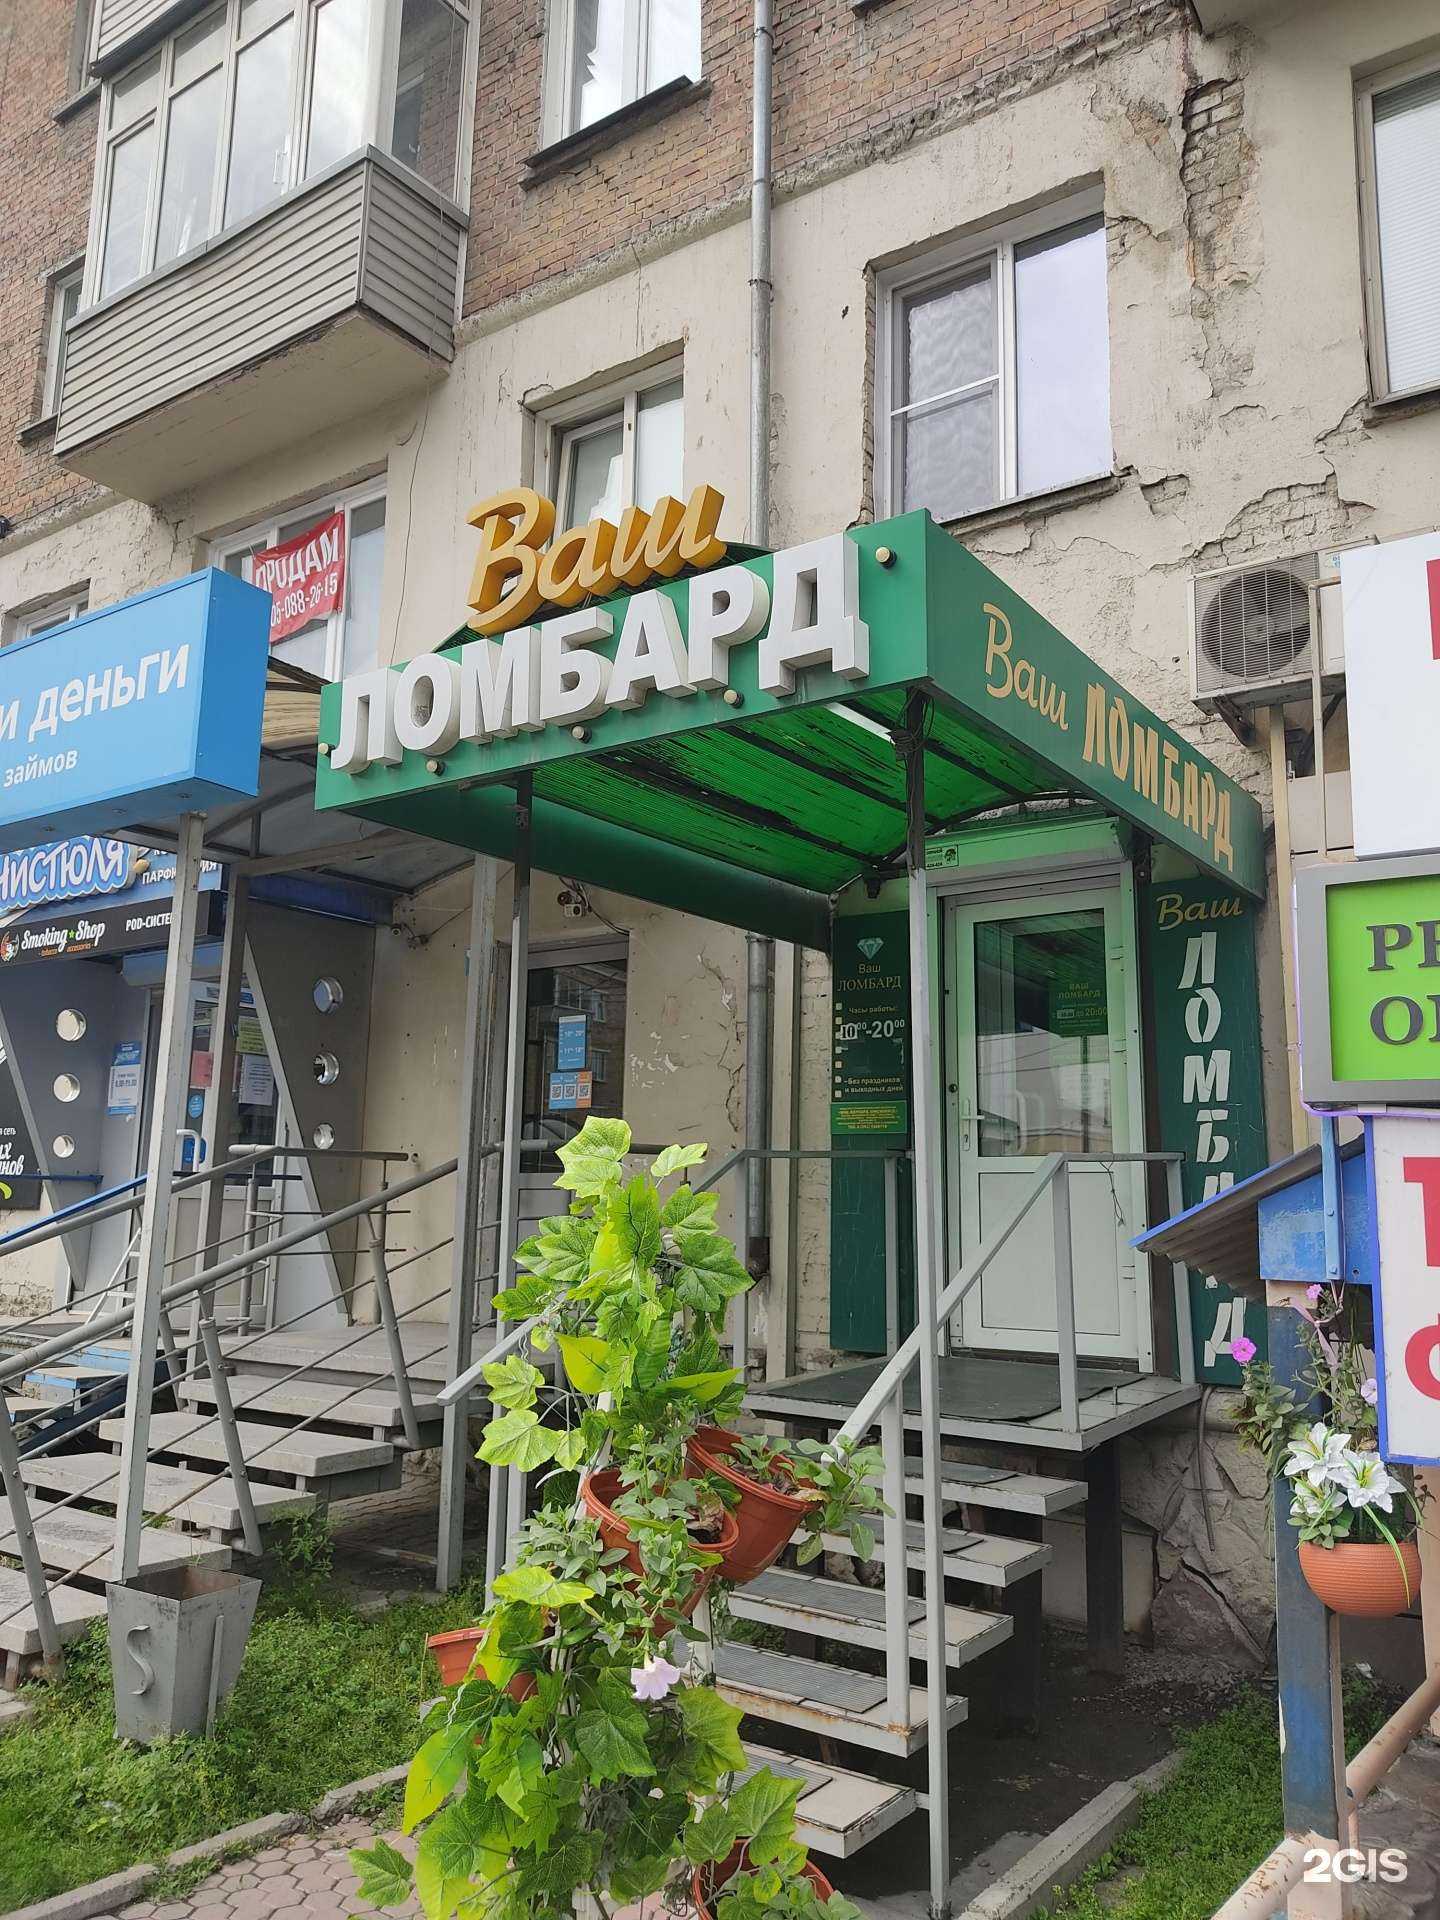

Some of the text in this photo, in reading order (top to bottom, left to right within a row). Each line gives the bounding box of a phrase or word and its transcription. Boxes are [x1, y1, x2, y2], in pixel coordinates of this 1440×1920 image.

[467, 484, 726, 635] Ваш
[331, 533, 869, 774] ЛОМБАРД
[28, 644, 190, 743] деньги
[983, 602, 1233, 872] Ваш ЛОМБАРД
[3, 750, 78, 788] займов
[125, 912, 173, 932] POD-СИСТЕ
[1157, 894, 1243, 931] Ваш
[21, 920, 105, 952] Smoking Shop
[837, 976, 902, 992] ЛОМБАРД
[858, 963, 881, 974] Ваш
[1370, 996, 1440, 1045] О
[1178, 931, 1246, 1367] ЛОМБД
